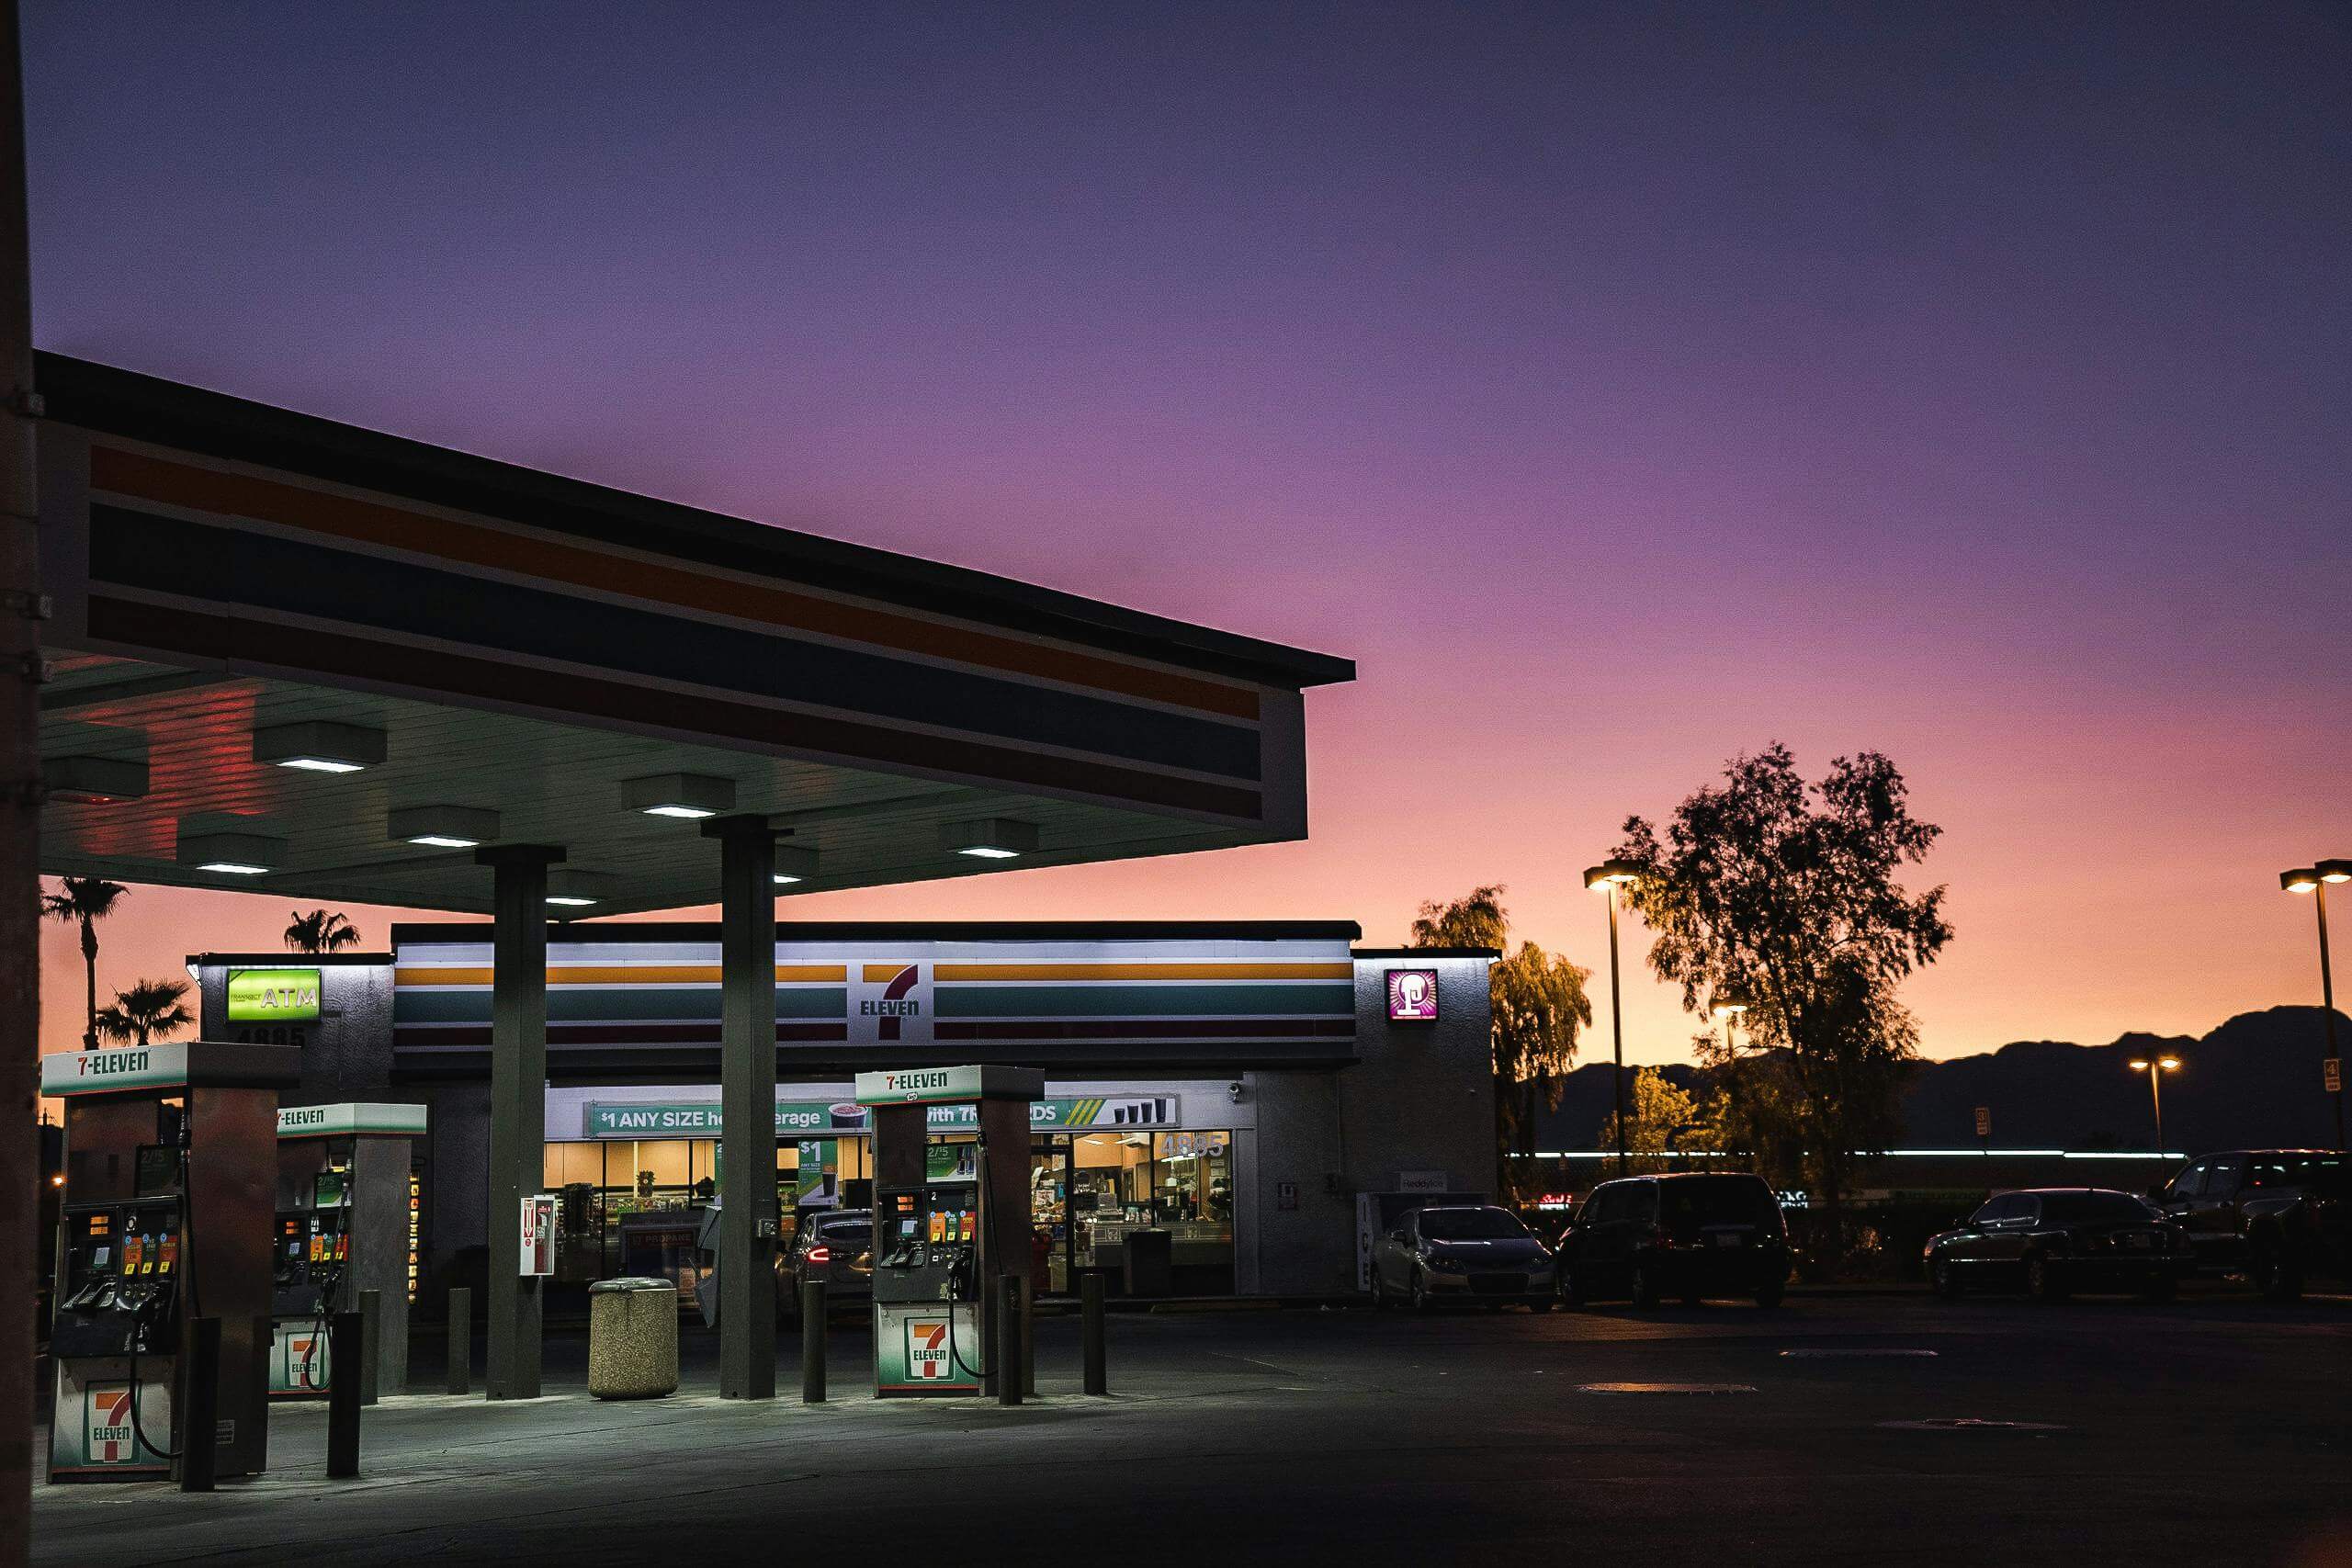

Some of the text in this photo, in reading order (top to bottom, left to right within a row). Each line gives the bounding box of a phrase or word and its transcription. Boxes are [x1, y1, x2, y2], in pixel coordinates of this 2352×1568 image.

[261, 988, 317, 1008] ATM
[601, 1112, 616, 1128] $1
[619, 1111, 660, 1127] ANY
[662, 1111, 704, 1127] SIZE
[800, 1141, 821, 1162] $1
[1160, 1134, 1224, 1157] 4885
[931, 1192, 938, 1201] 2
[646, 1233, 692, 1243] PROPANE
